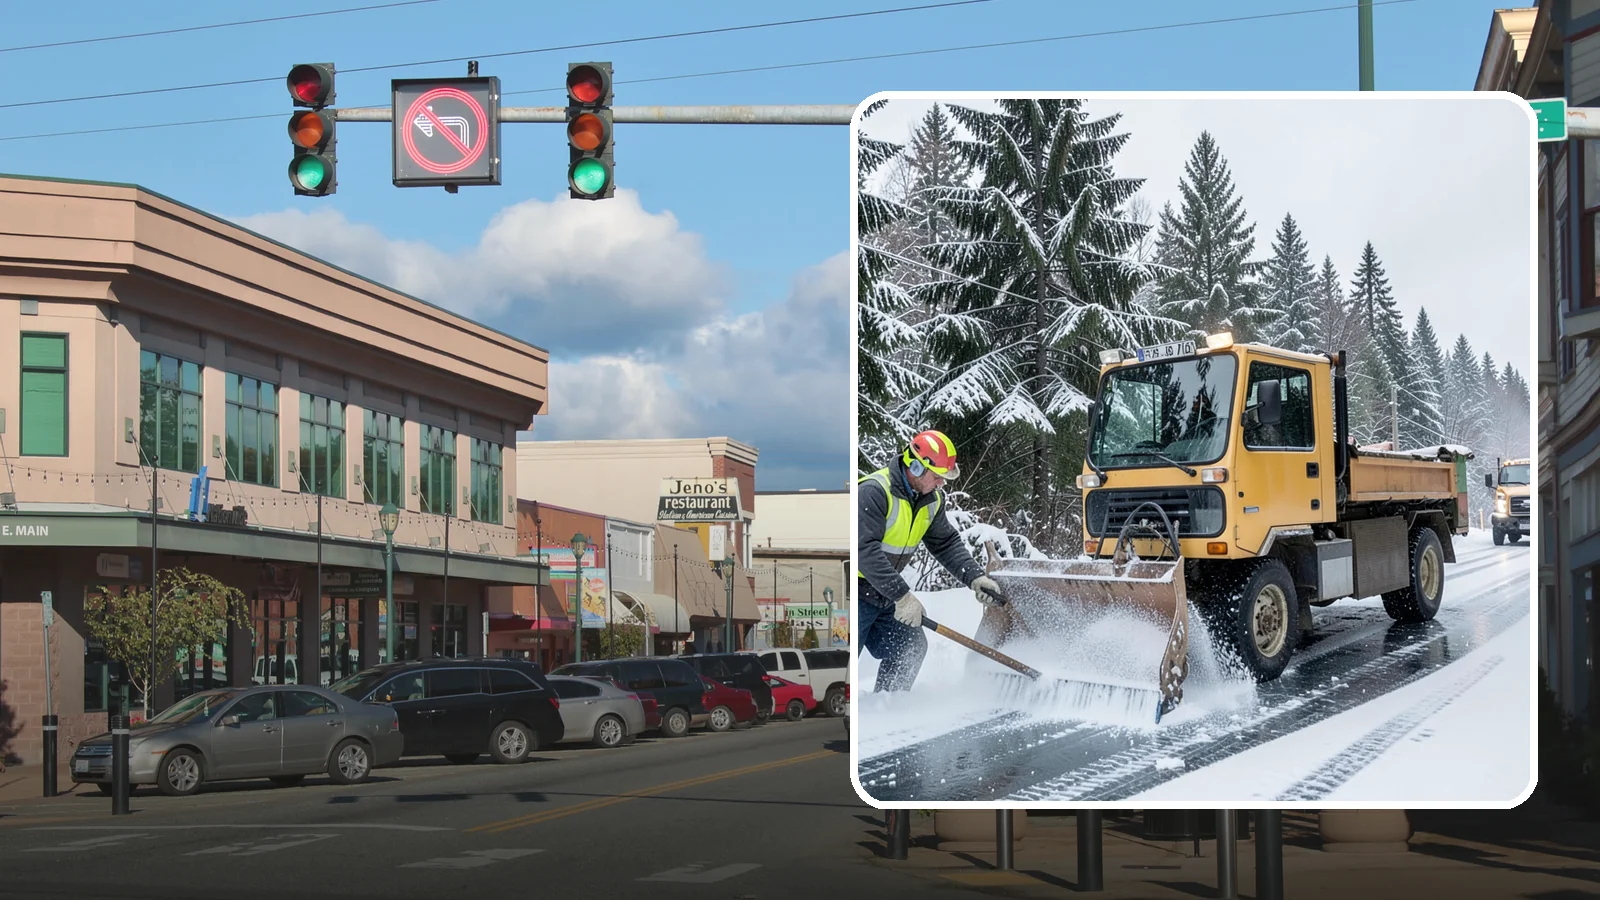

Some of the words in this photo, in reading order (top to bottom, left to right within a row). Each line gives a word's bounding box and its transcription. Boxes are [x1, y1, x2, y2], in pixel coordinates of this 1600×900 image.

[670, 480, 727, 494] Jeno's
[665, 497, 731, 509] restaurant
[658, 510, 681, 520] Italian
[686, 510, 714, 519] American
[715, 509, 737, 519] Cuisine
[2, 525, 13, 536] E.
[15, 525, 49, 536] MAIN
[797, 608, 828, 617] Street
[791, 619, 824, 627] lass
